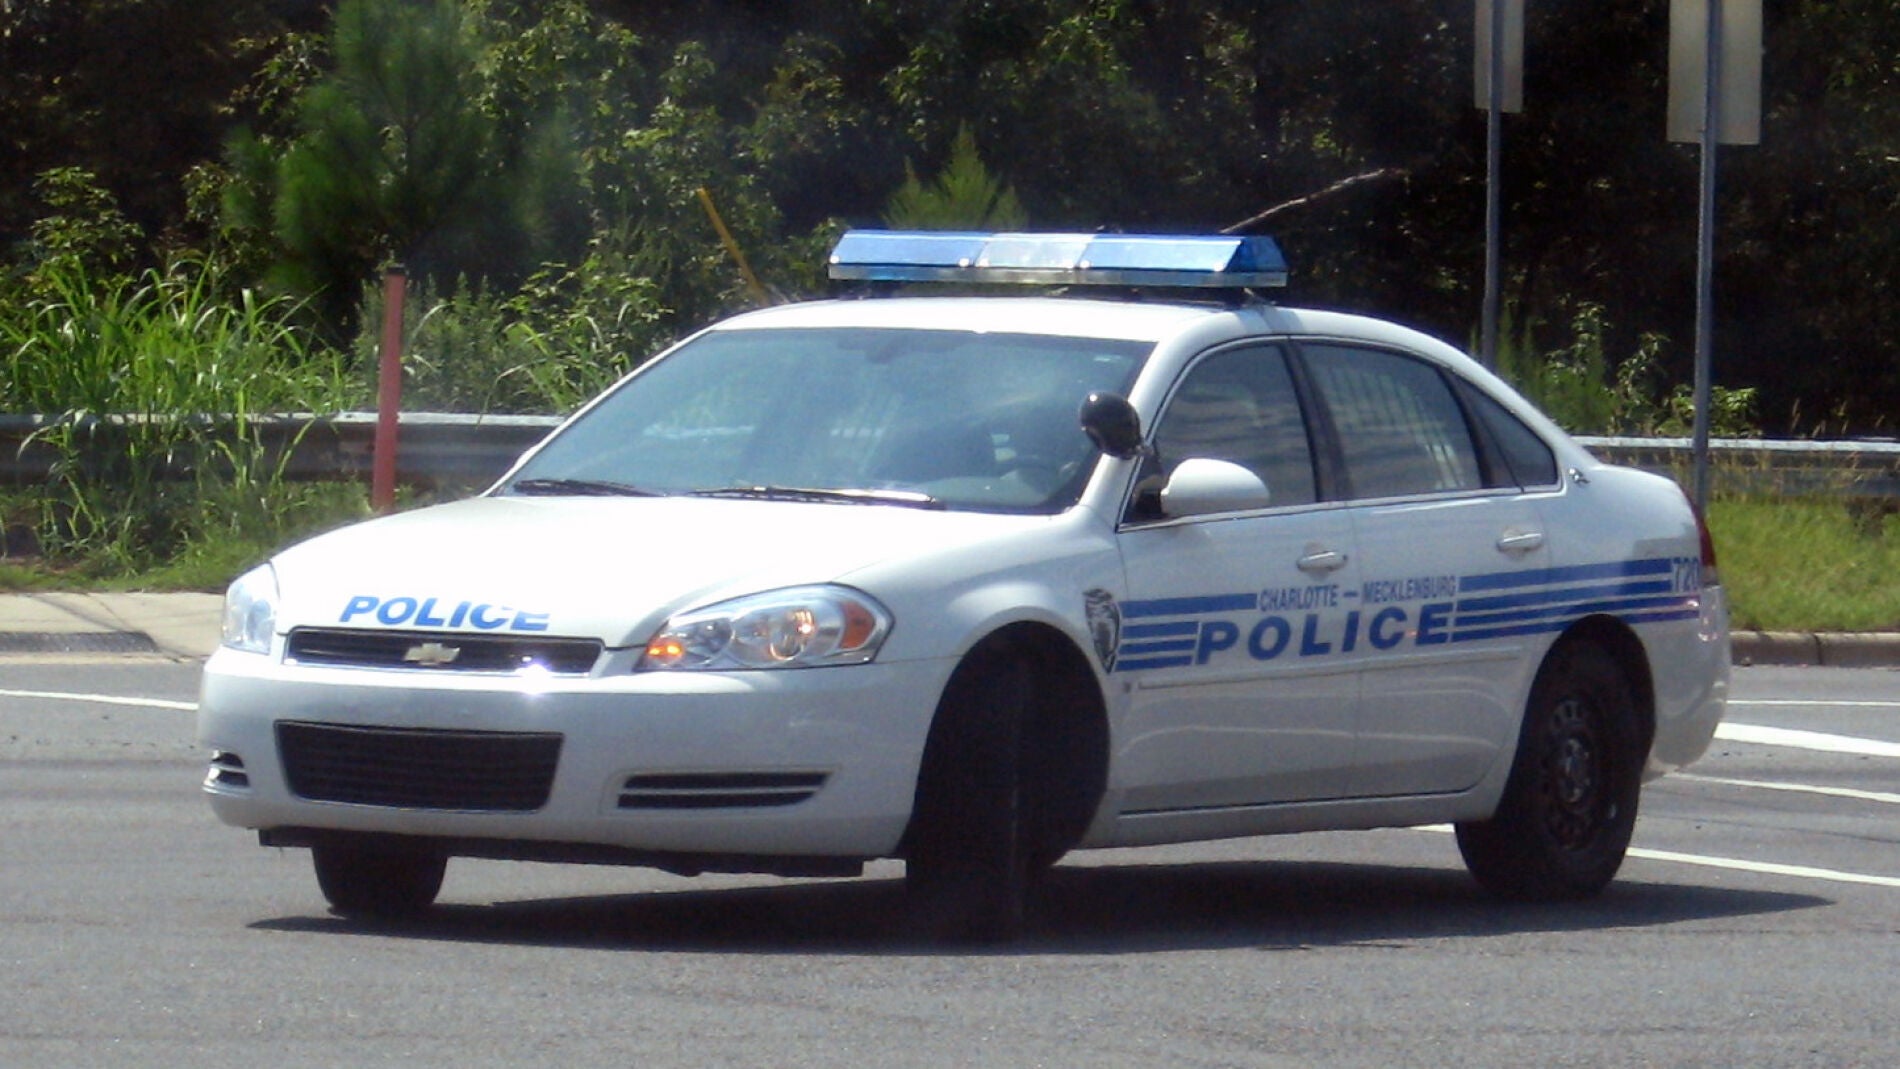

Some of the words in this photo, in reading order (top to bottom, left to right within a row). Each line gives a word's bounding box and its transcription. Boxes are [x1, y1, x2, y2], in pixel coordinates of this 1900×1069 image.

[1260, 583, 1339, 612] CHARLOTTE
[1362, 575, 1458, 604] MECKLENBURG
[338, 595, 551, 632] POLICE
[1195, 602, 1455, 666] POLICE
